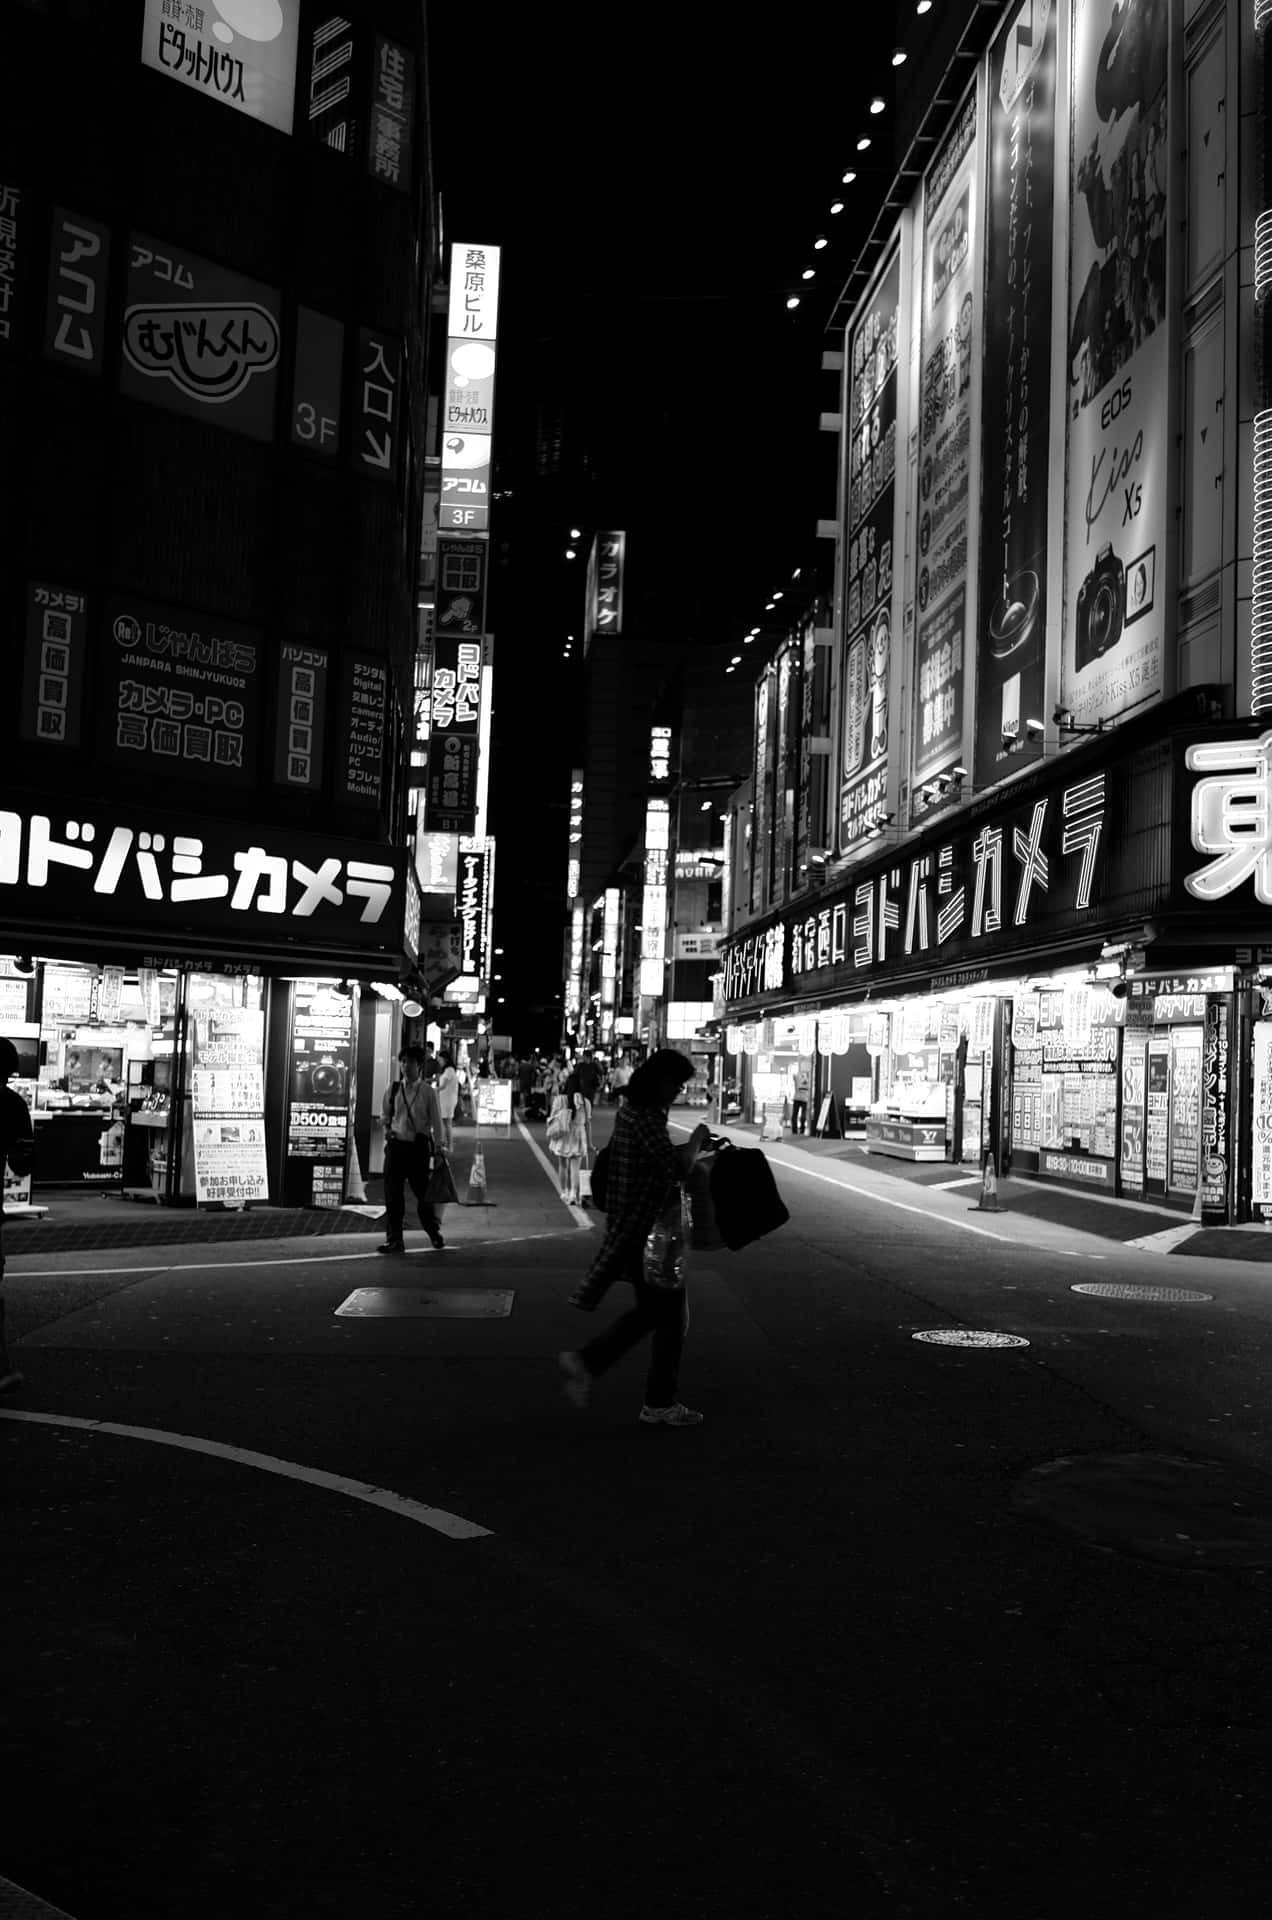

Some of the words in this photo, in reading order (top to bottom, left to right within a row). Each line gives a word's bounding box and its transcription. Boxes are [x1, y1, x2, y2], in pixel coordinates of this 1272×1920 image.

[158, 21, 245, 103] ピタットハウス
[54, 221, 100, 360] アコム
[130, 245, 195, 290] アコム
[463, 249, 486, 333] 桑原ビル
[138, 318, 268, 386] むじんくん
[362, 341, 398, 423] 入口
[1101, 376, 1132, 429] EOS
[295, 401, 337, 444] 3F
[448, 405, 489, 425] ピタットハウス
[443, 477, 486, 494] アコム
[1085, 429, 1143, 545] Kiss
[1123, 483, 1143, 527] X5
[452, 510, 475, 525] 3F
[34, 586, 86, 613] カメラ!
[597, 541, 618, 625] カラオケ
[121, 654, 172, 673] JANPARA
[145, 620, 257, 674] じゃんぱら
[36, 609, 73, 741] 高価買取
[433, 668, 456, 727] カメラ
[456, 643, 480, 721] ヨドバシ
[117, 679, 245, 730] カメラ・PC
[287, 666, 316, 784] 高価買取
[116, 712, 244, 768] 高価買取
[348, 755, 361, 767] PC
[853, 773, 1106, 968] ヨドバシカメラ
[142, 955, 213, 972] ヨドバシカメラ
[791, 901, 847, 975] 新宿西口
[1131, 975, 1227, 994] ヨドバシカメラ
